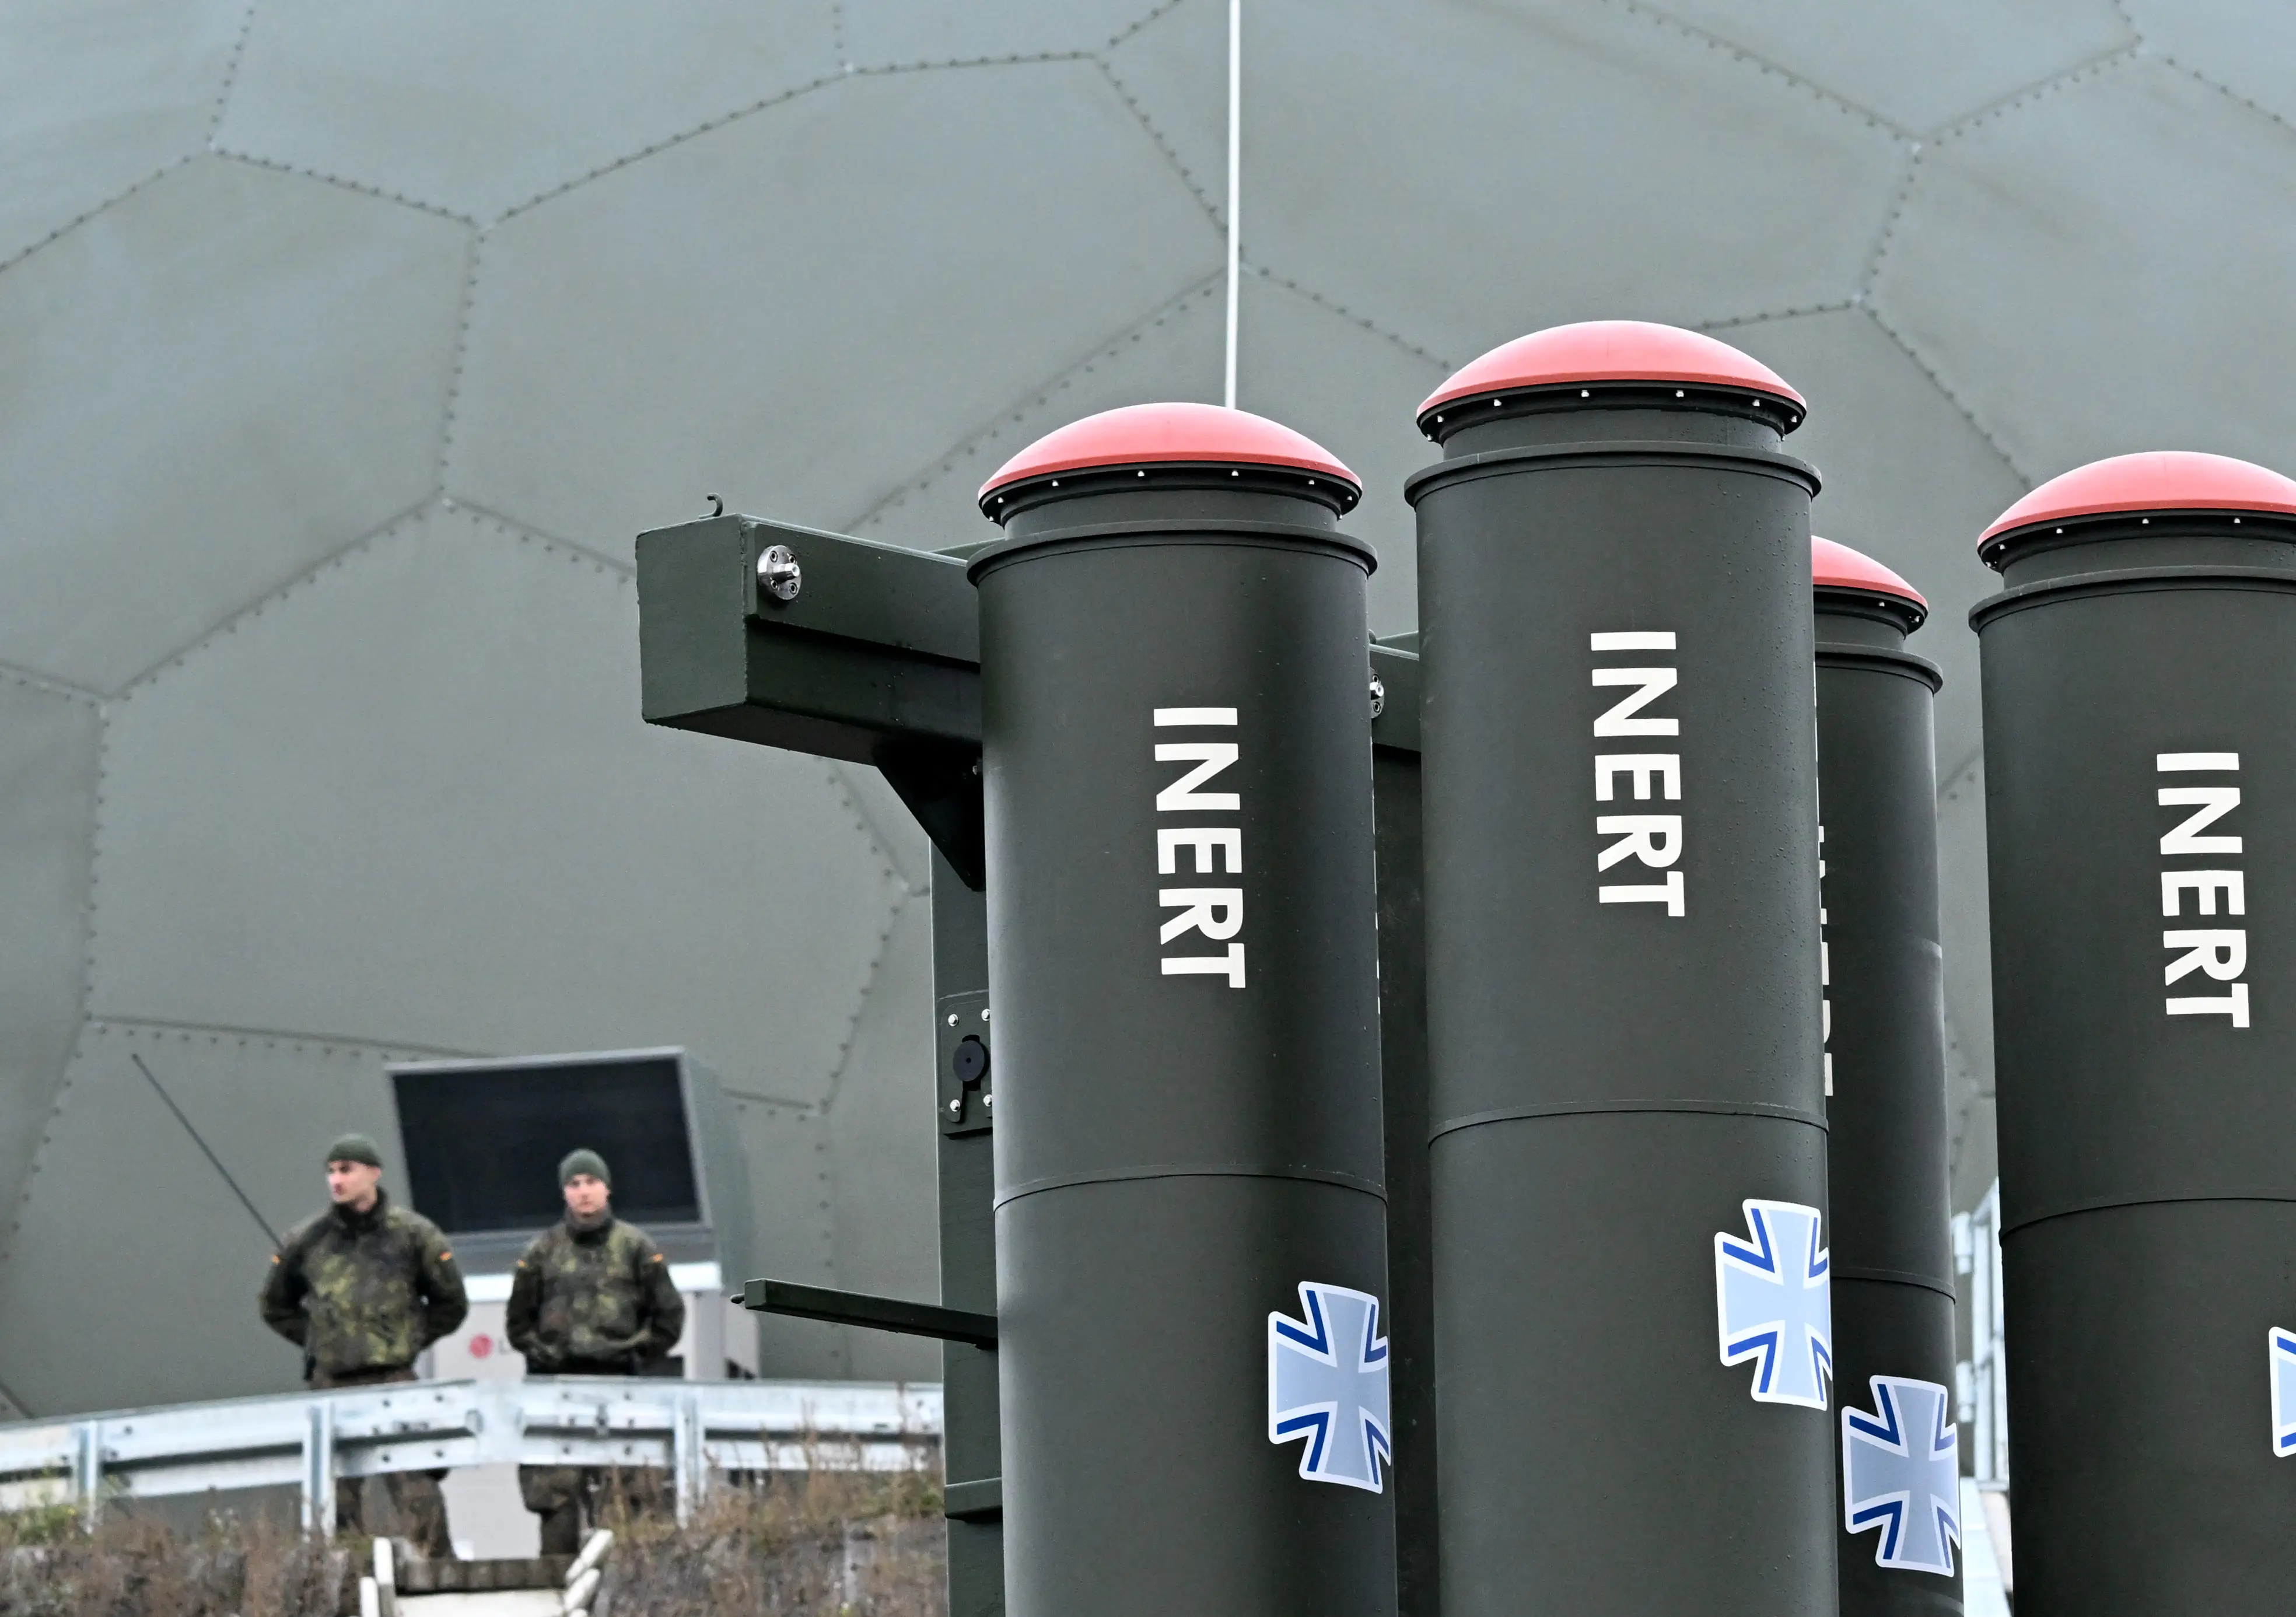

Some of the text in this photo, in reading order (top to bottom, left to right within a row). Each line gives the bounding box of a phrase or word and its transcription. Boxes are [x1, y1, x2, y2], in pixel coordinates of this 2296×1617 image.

[1153, 707, 1246, 988] INERT
[1590, 631, 1685, 917] INERT
[2157, 752, 2250, 1028] INERT
